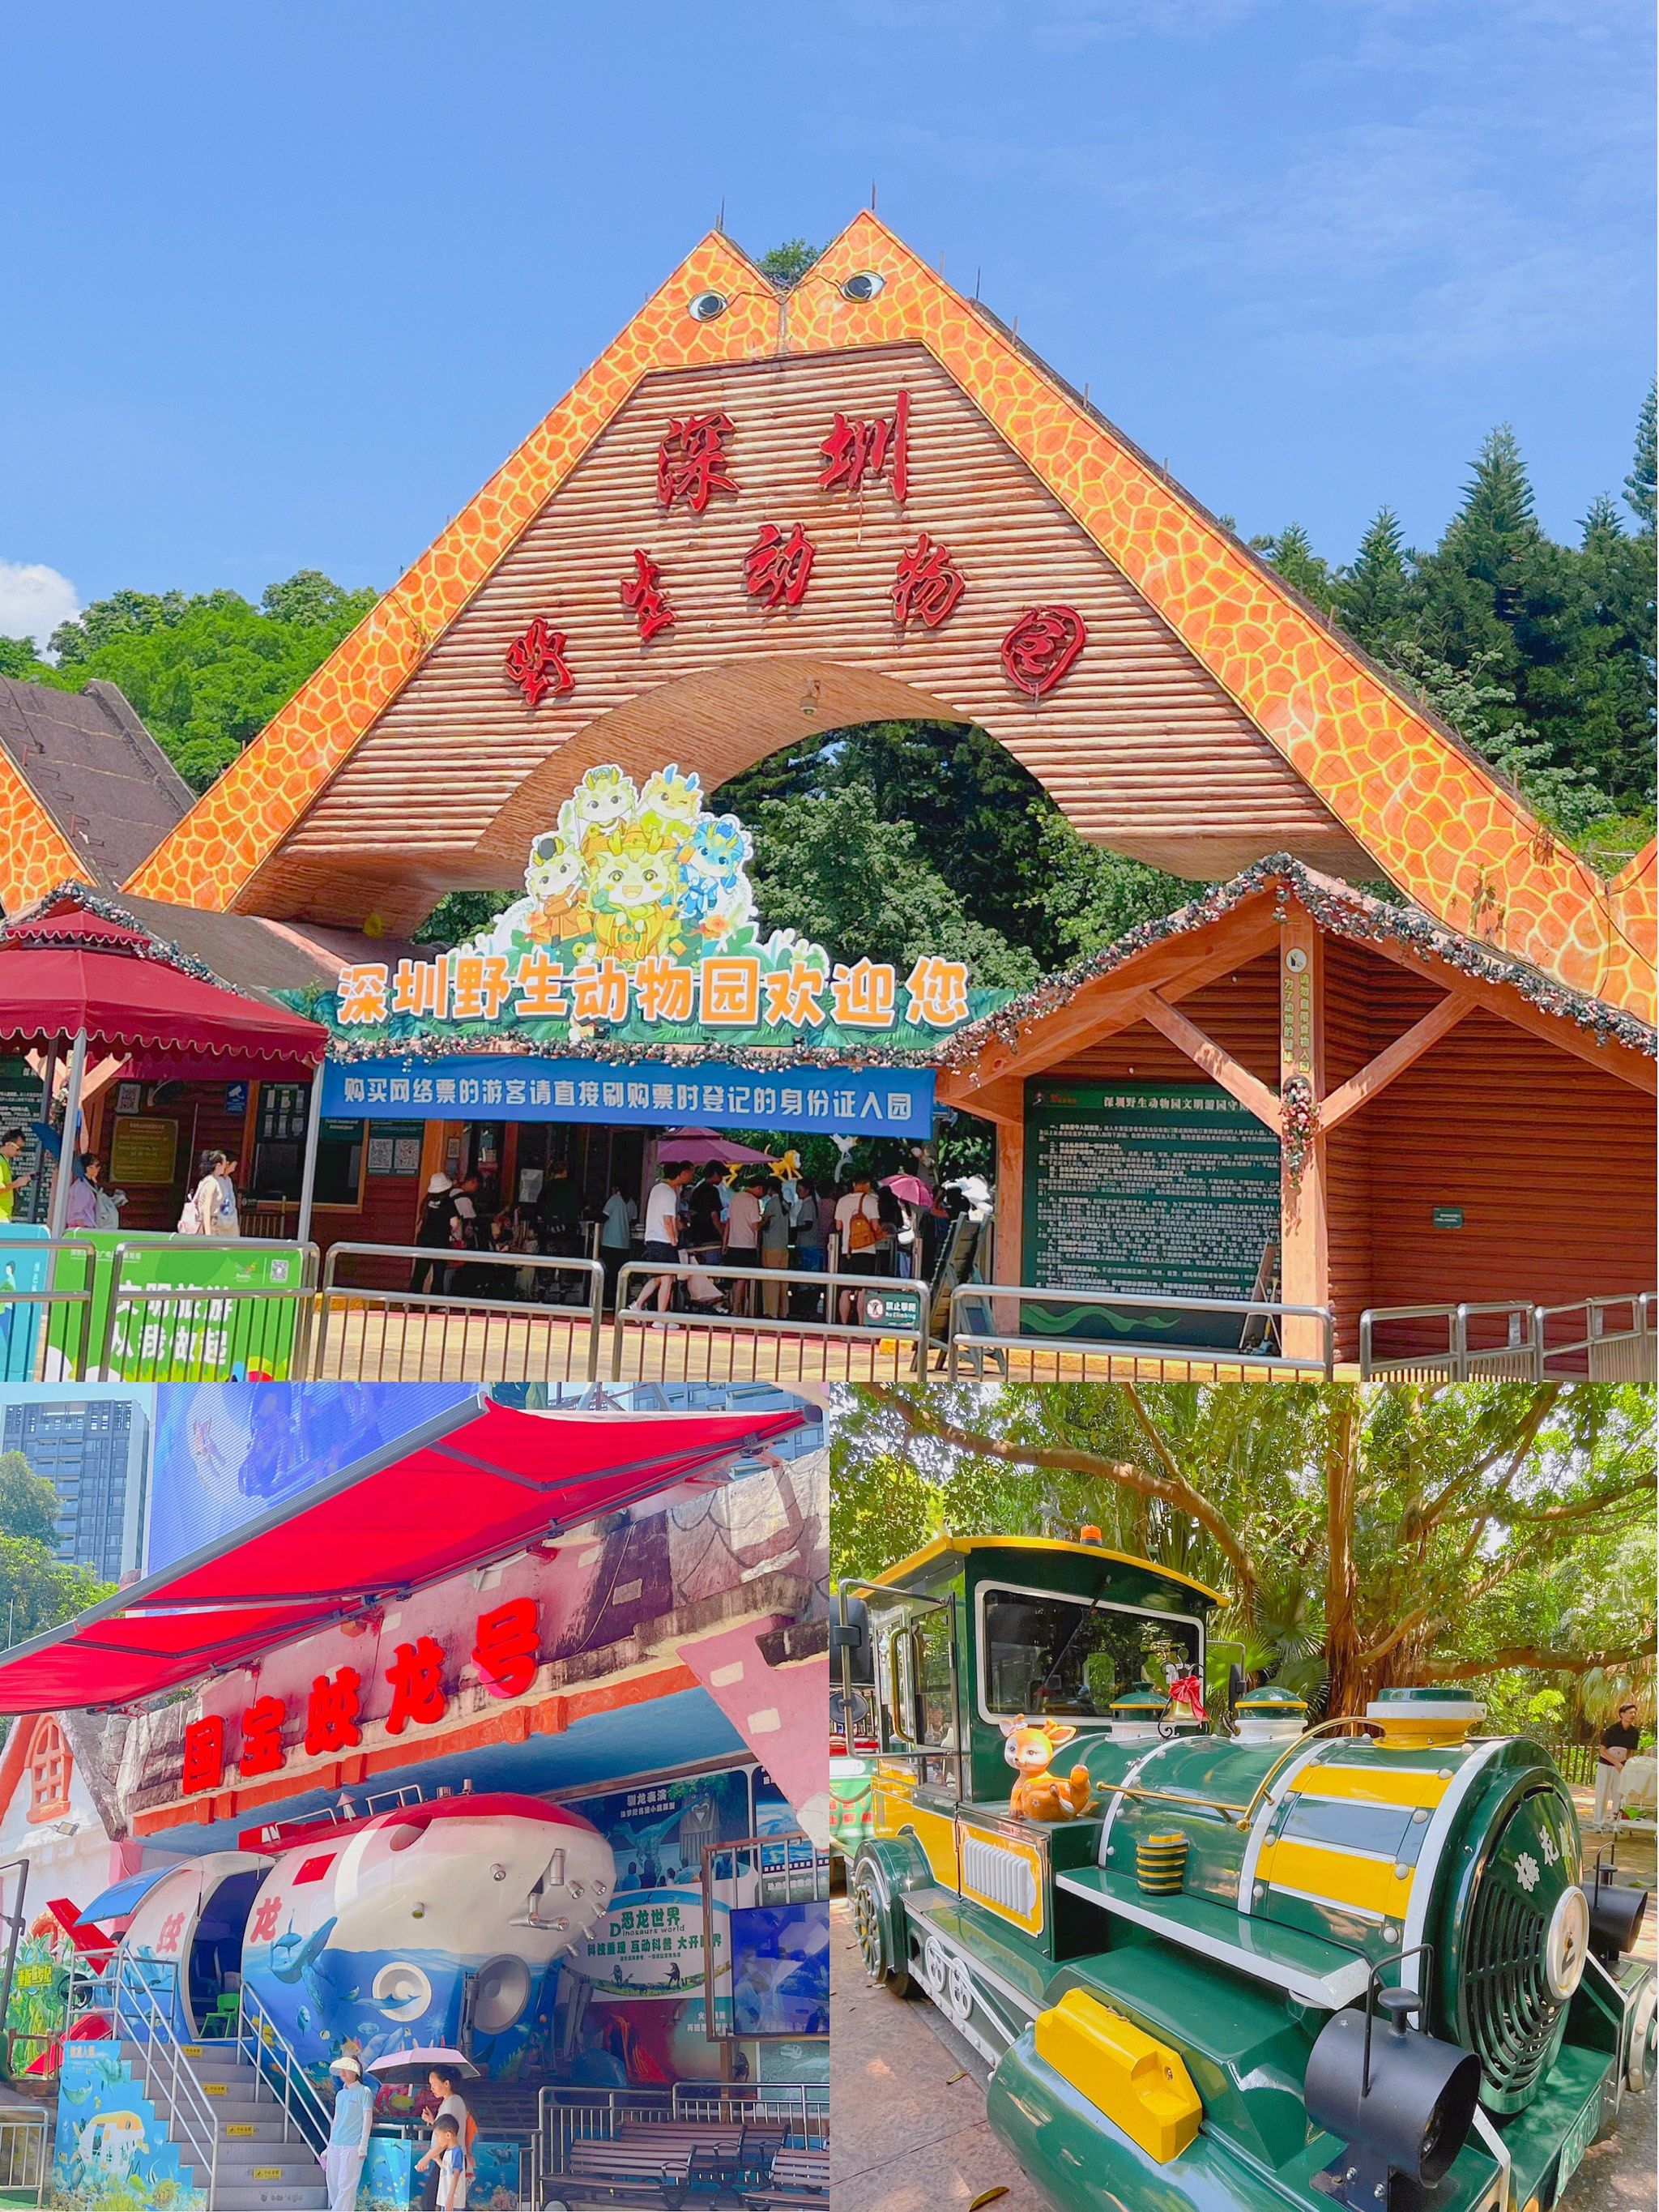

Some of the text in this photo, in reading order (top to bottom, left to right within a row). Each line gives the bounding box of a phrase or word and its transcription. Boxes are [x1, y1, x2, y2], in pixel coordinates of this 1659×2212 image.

[655, 390, 911, 513] 深圳
[338, 953, 970, 1028] 深圳野生动物园欢迎您
[344, 1078, 911, 1121] 购买网络票的游客请直接刷购票时登记的身份证入园
[112, 1321, 228, 1364] 从我做起
[183, 1598, 539, 1795] 国宝蛟龙号
[610, 1923, 684, 1937] Dinosaurs world
[621, 1907, 680, 1929] 恐龙世界
[631, 1937, 672, 1954] 互动科普
